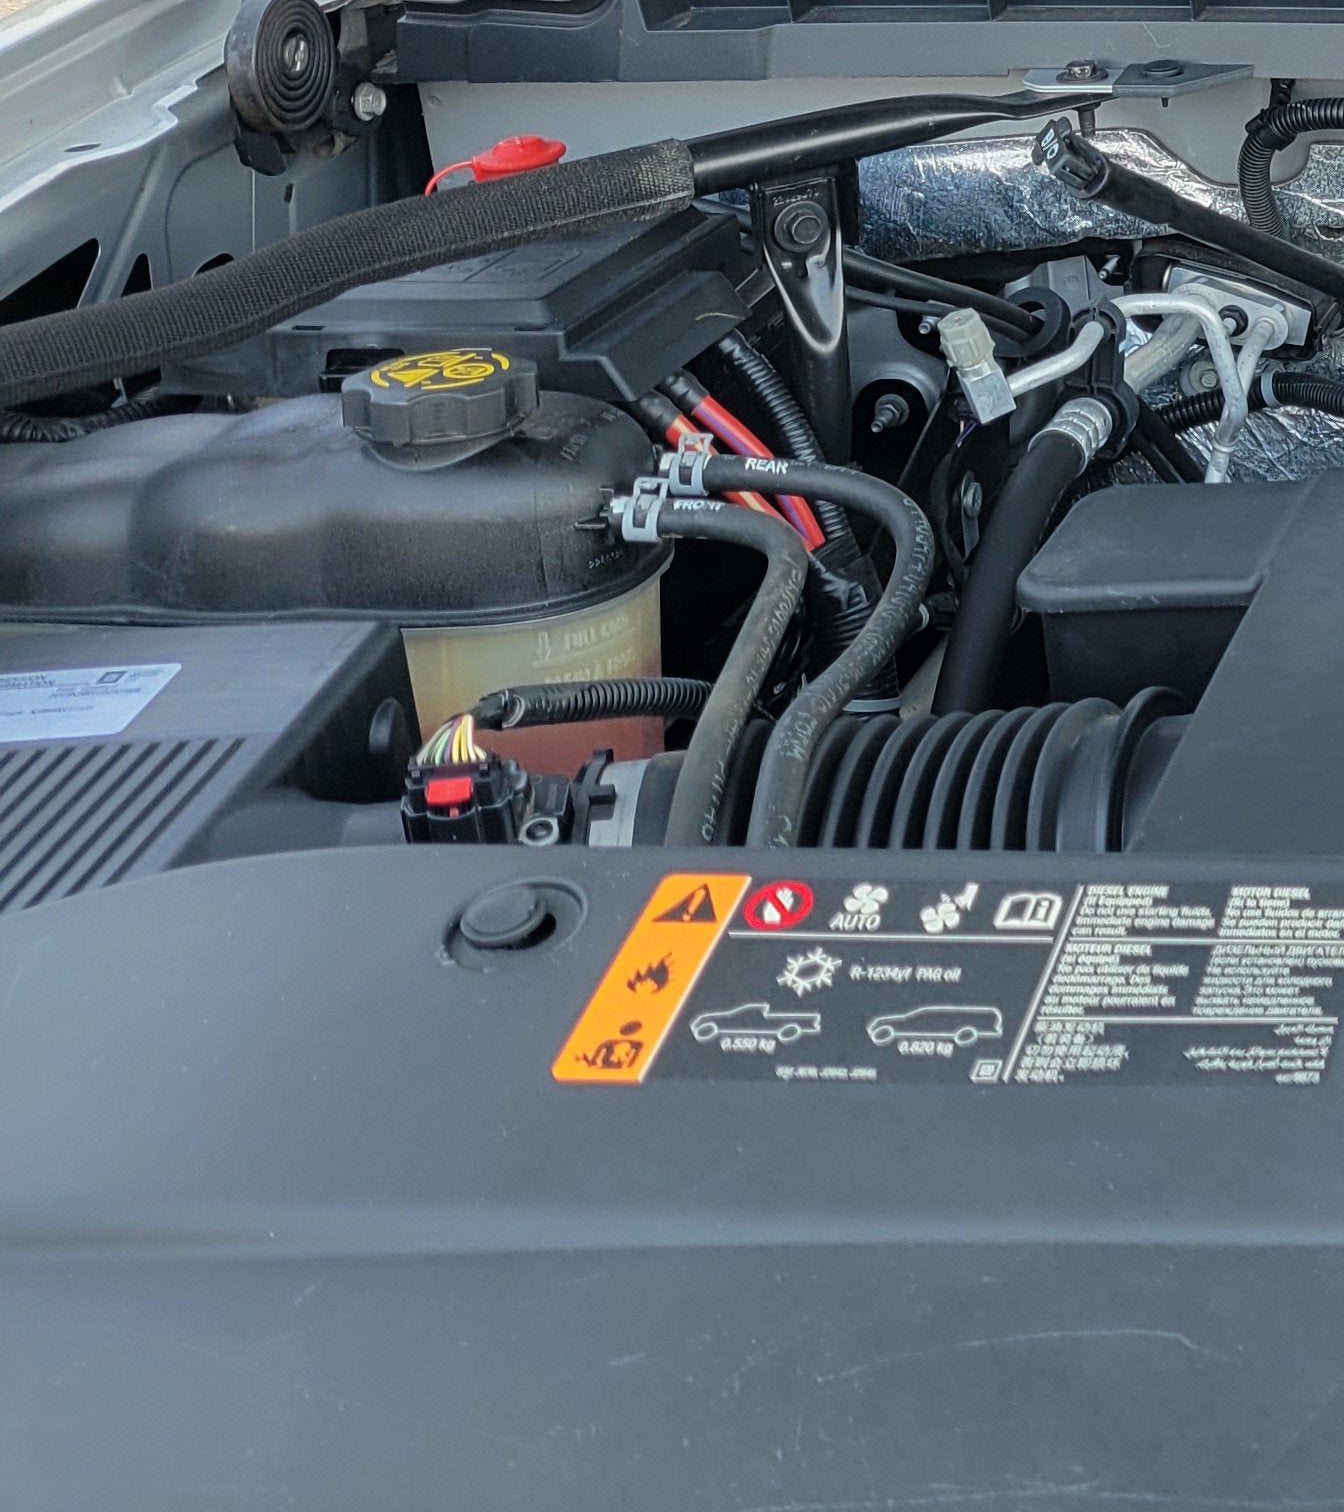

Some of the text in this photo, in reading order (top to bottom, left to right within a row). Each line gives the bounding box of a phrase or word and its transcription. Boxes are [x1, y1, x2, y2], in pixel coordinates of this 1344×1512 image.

[744, 457, 789, 475] REAR
[1087, 885, 1169, 899] DIESEL ENGINE
[1231, 886, 1311, 900] MOTOR DIESEL
[1080, 906, 1095, 916] Do
[1097, 906, 1114, 916] not
[1116, 907, 1135, 917] use
[1137, 906, 1179, 918] starting
[829, 913, 881, 931] AUTO
[1134, 918, 1170, 929] engine
[1171, 917, 1215, 930] damage
[1071, 927, 1092, 936] can
[1065, 944, 1152, 956] MOTEUR DIESEL
[915, 967, 942, 983] PAG
[720, 1038, 776, 1054] 0.550 kg
[897, 1041, 954, 1058] 0.820 kg
